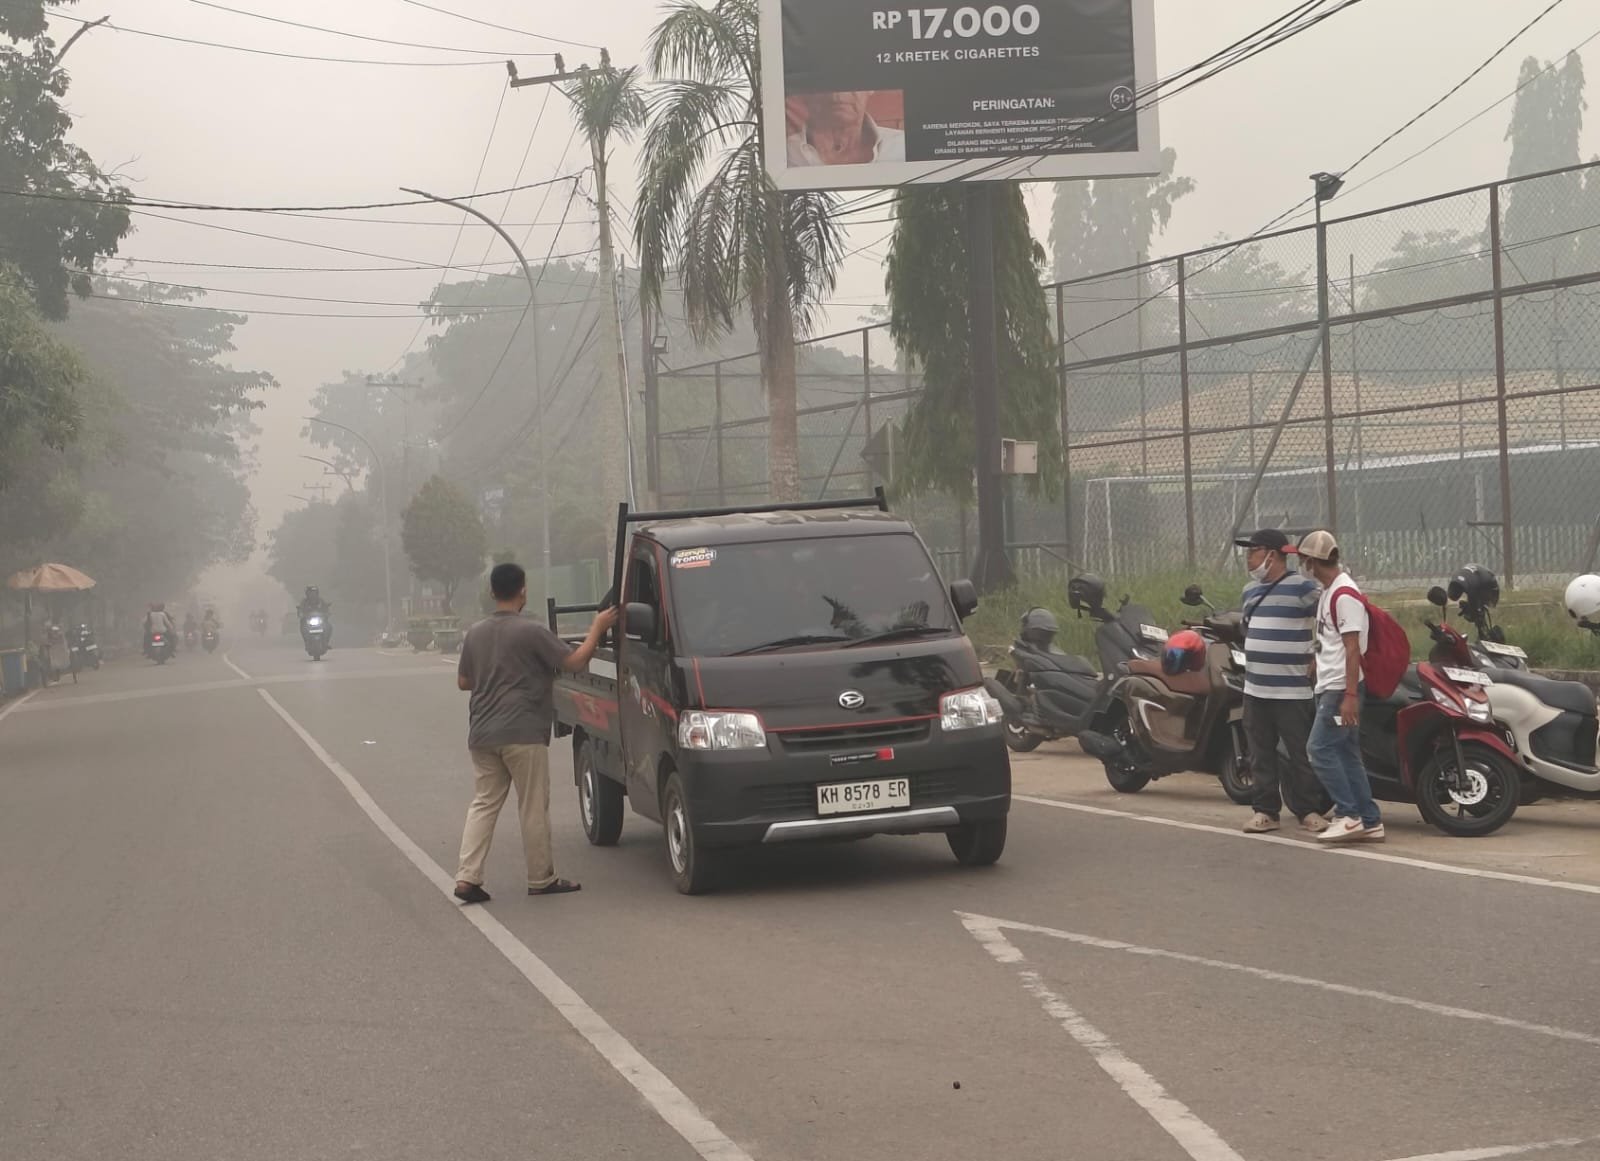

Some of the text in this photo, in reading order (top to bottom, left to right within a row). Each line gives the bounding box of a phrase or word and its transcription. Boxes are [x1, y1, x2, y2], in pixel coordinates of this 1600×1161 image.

[872, 4, 1041, 39] RP 17.000
[876, 46, 1040, 64] 12 KRETEK CIGARETTES
[972, 98, 1056, 111] PERINGATAN:
[821, 781, 906, 804] KH 8578 ER
